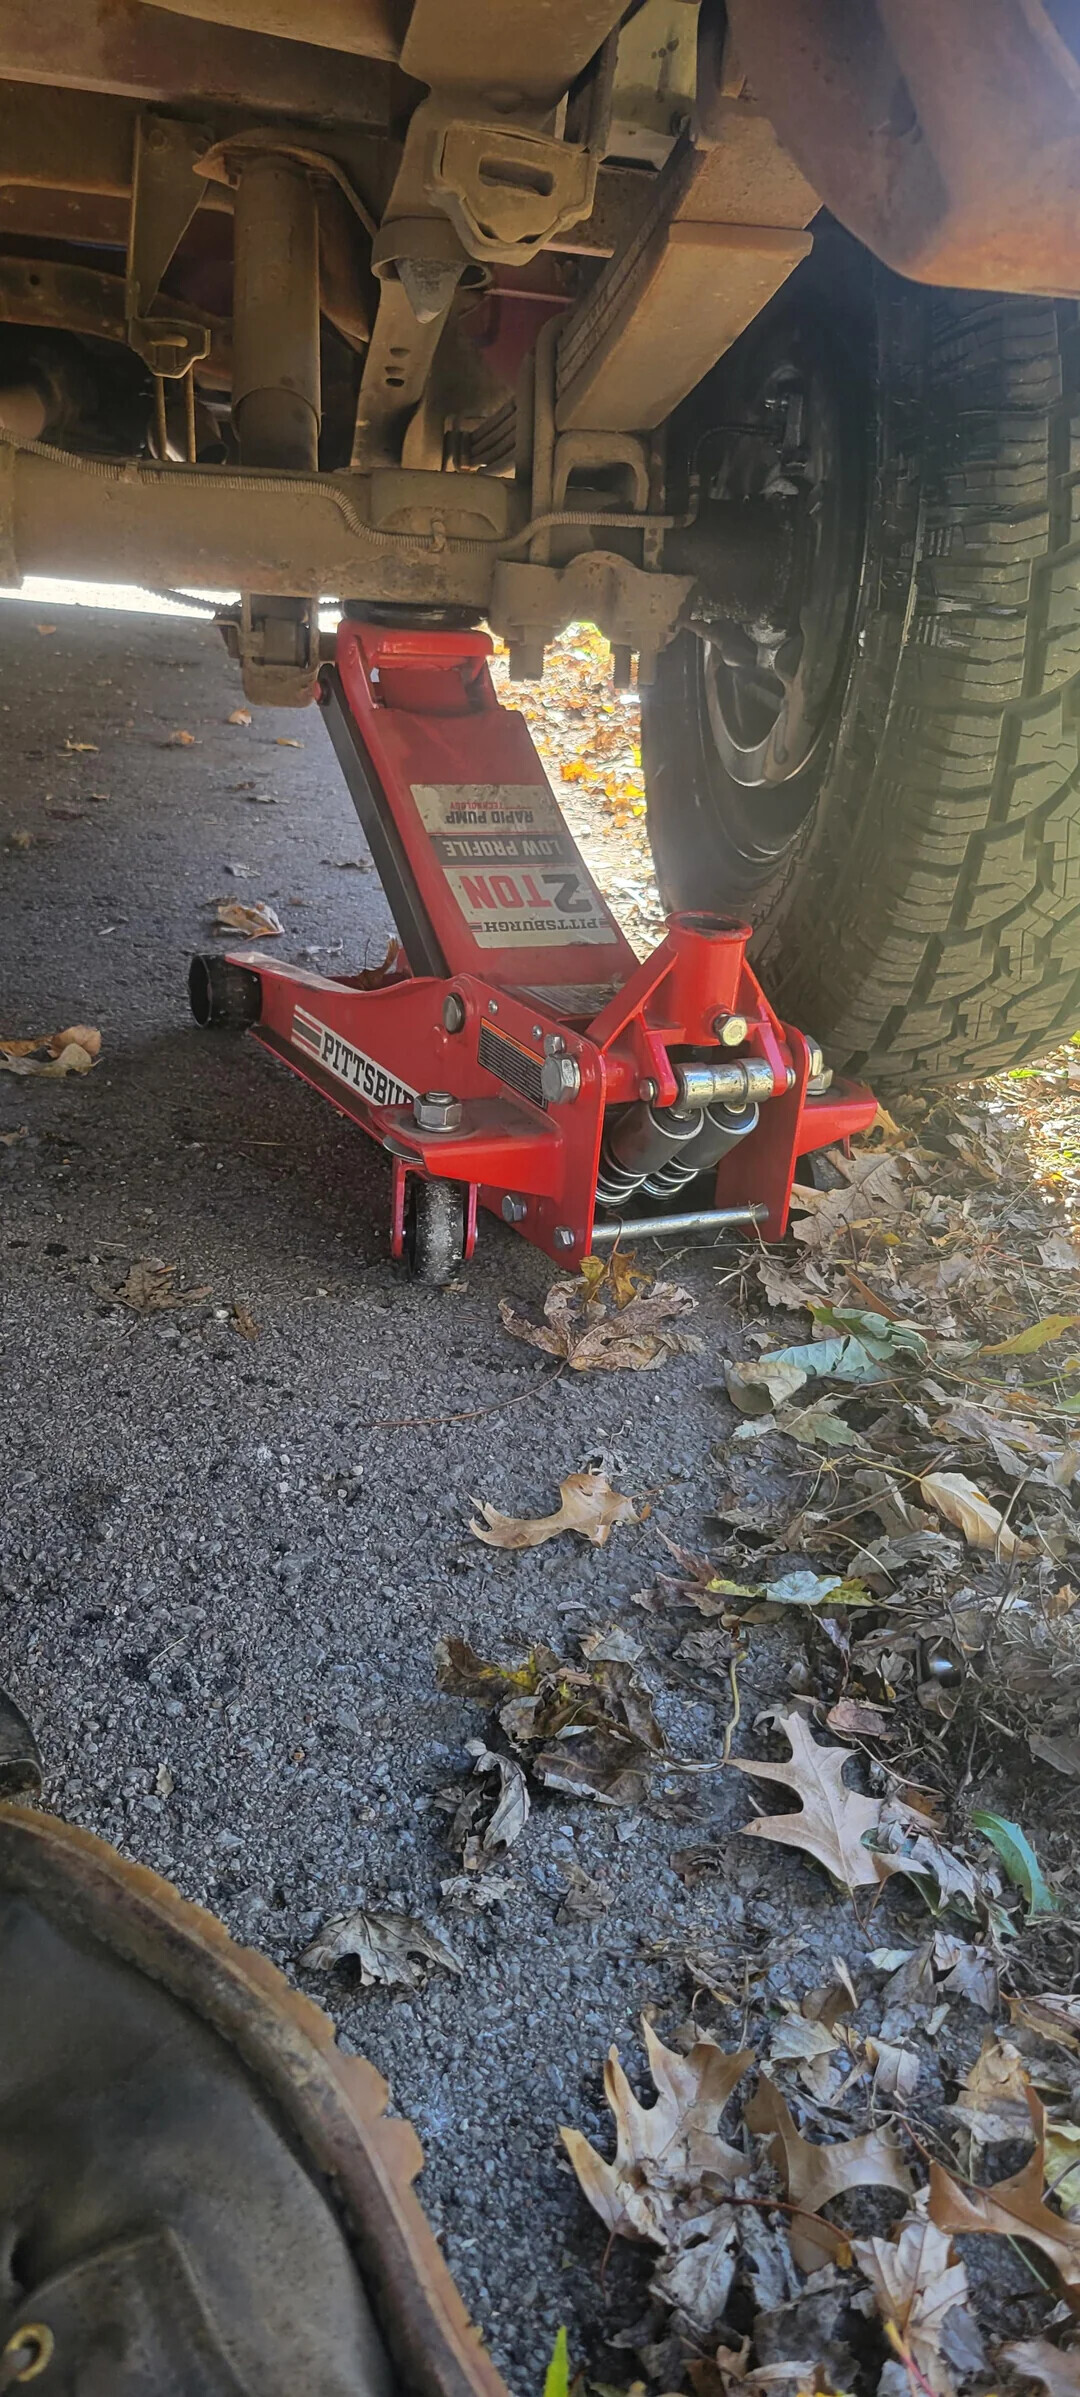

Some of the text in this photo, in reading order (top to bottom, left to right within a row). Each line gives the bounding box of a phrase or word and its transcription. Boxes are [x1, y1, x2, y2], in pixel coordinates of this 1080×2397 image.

[450, 802, 503, 810] TECHNOLOGY
[446, 810, 534, 825] RAPID PUMP
[443, 841, 563, 857] LOW PROFILE
[459, 874, 593, 914] 2 TON
[485, 918, 599, 932] PITTSBURGH
